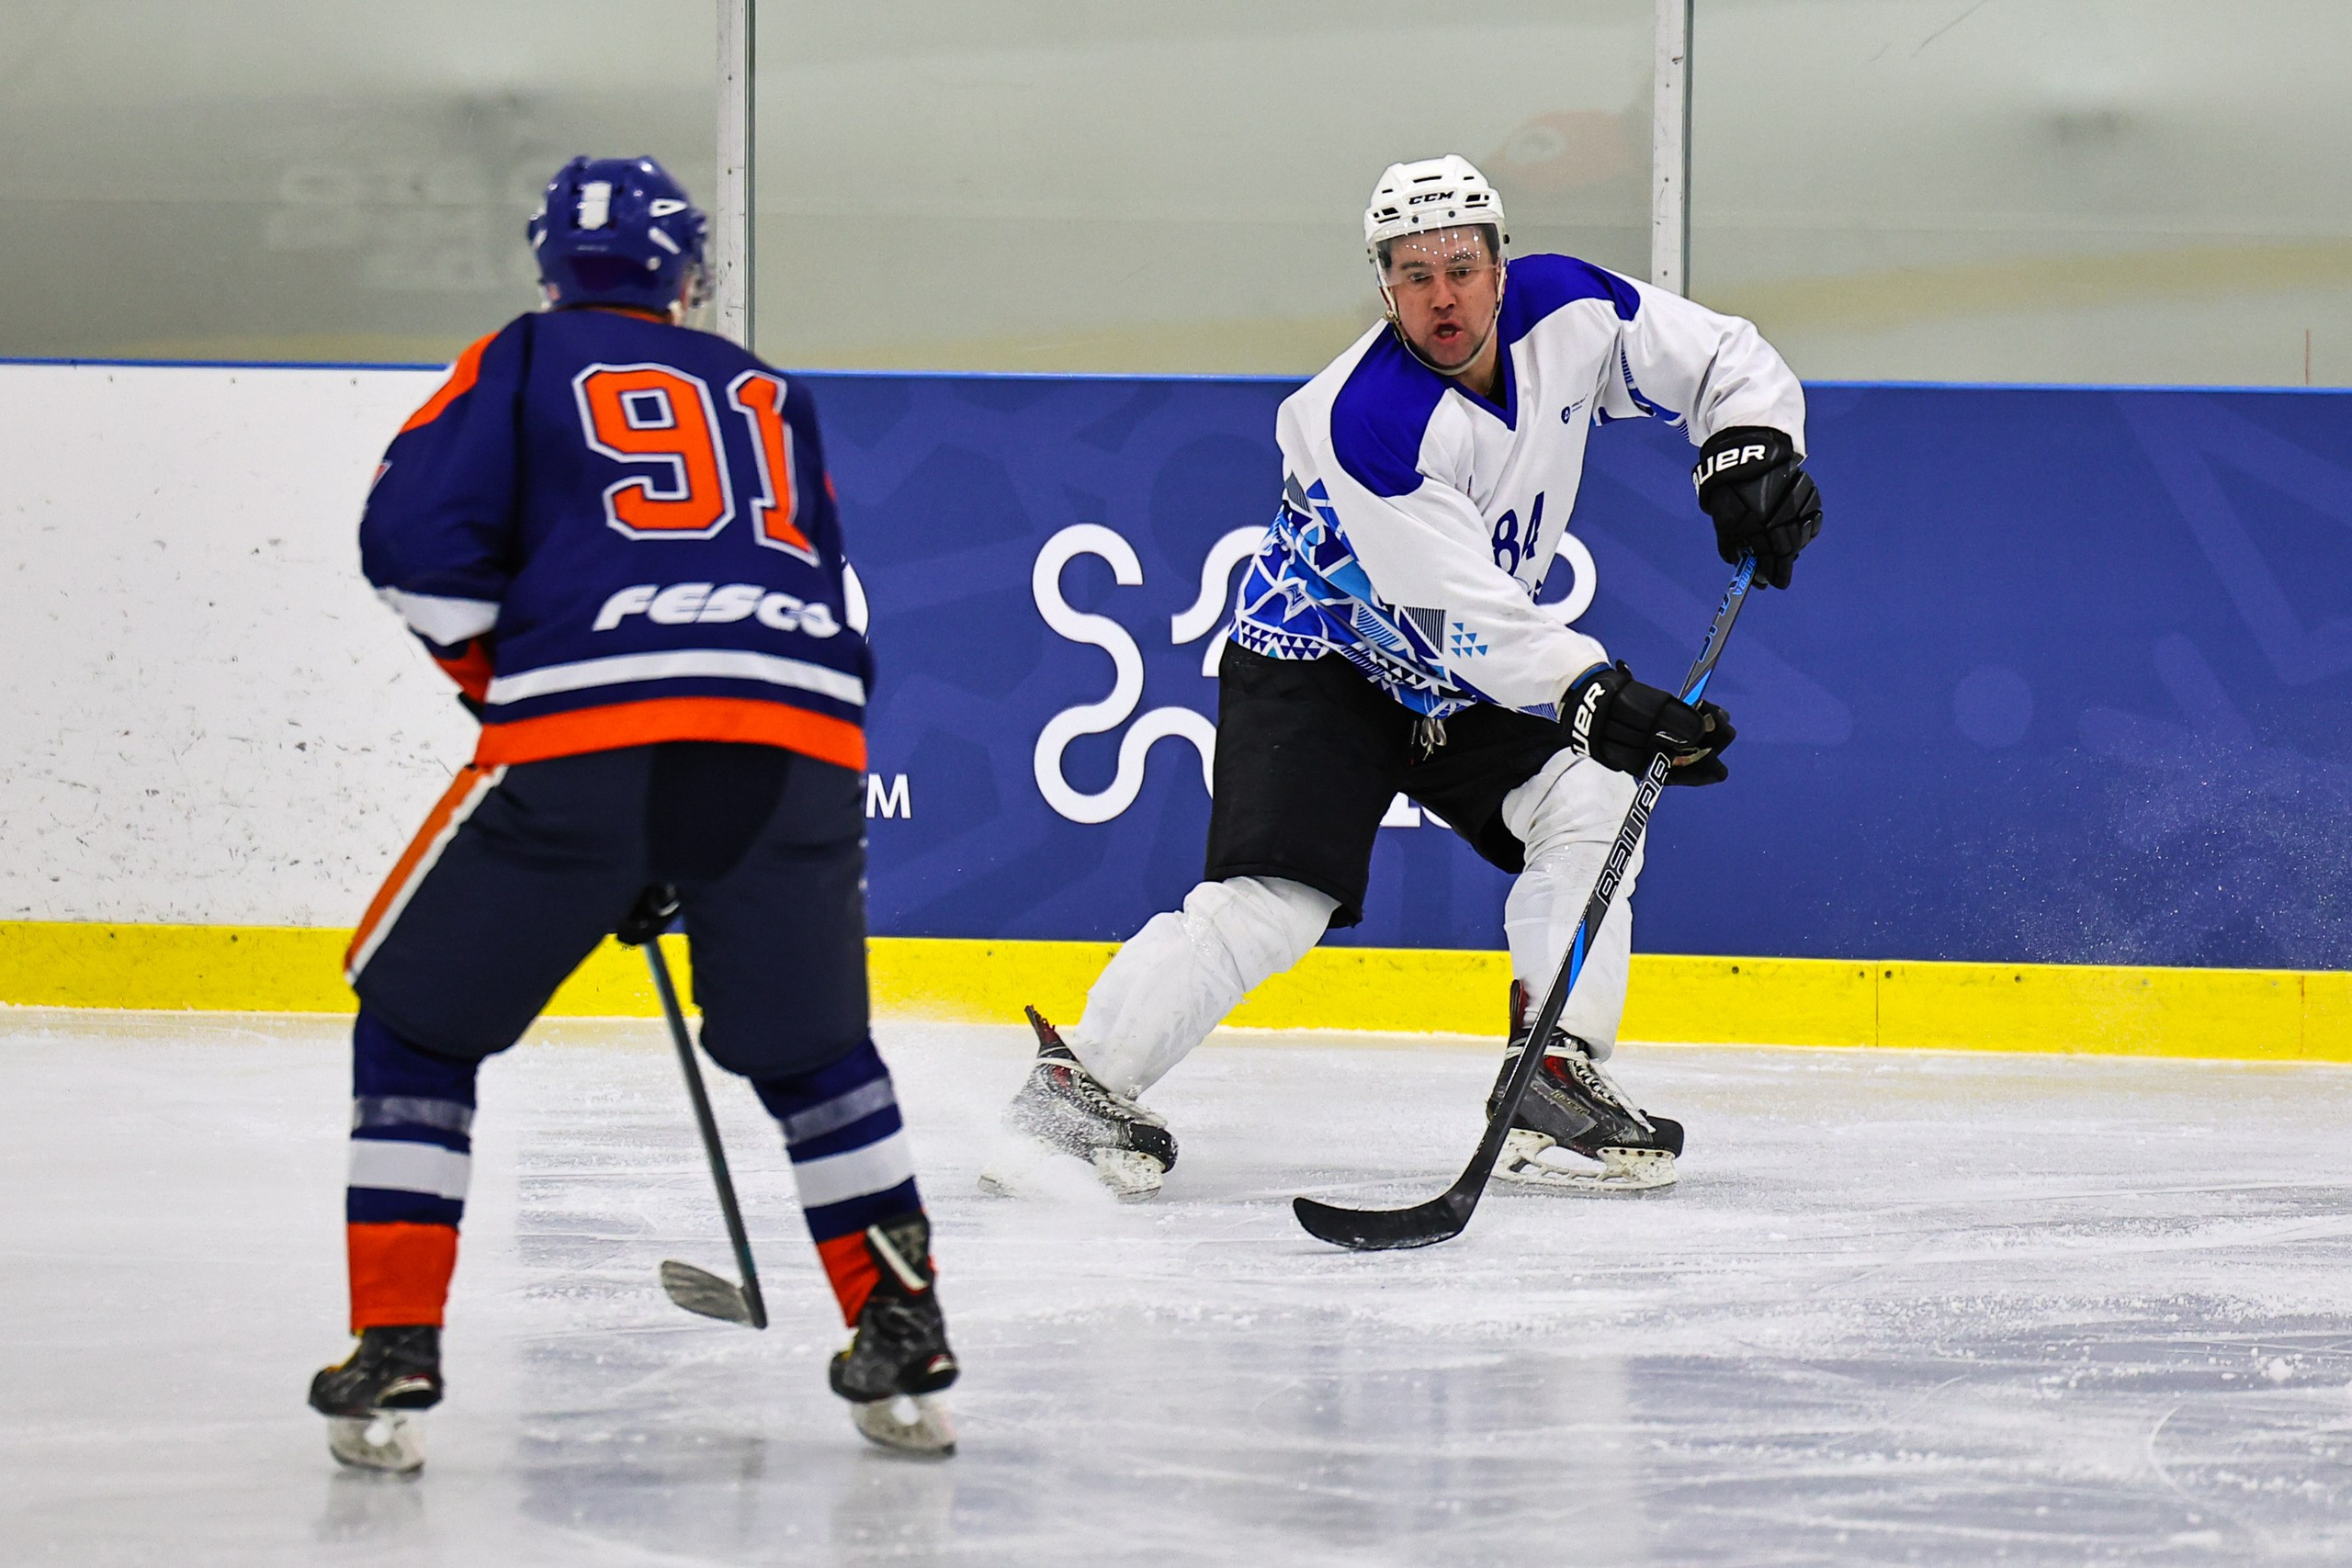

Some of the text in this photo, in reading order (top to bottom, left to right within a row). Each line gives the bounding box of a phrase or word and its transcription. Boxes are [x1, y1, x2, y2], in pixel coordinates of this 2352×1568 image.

[1408, 191, 1454, 205] CCM
[571, 362, 820, 568] 91
[1491, 491, 1544, 577] 84
[592, 581, 842, 638] FESCO
